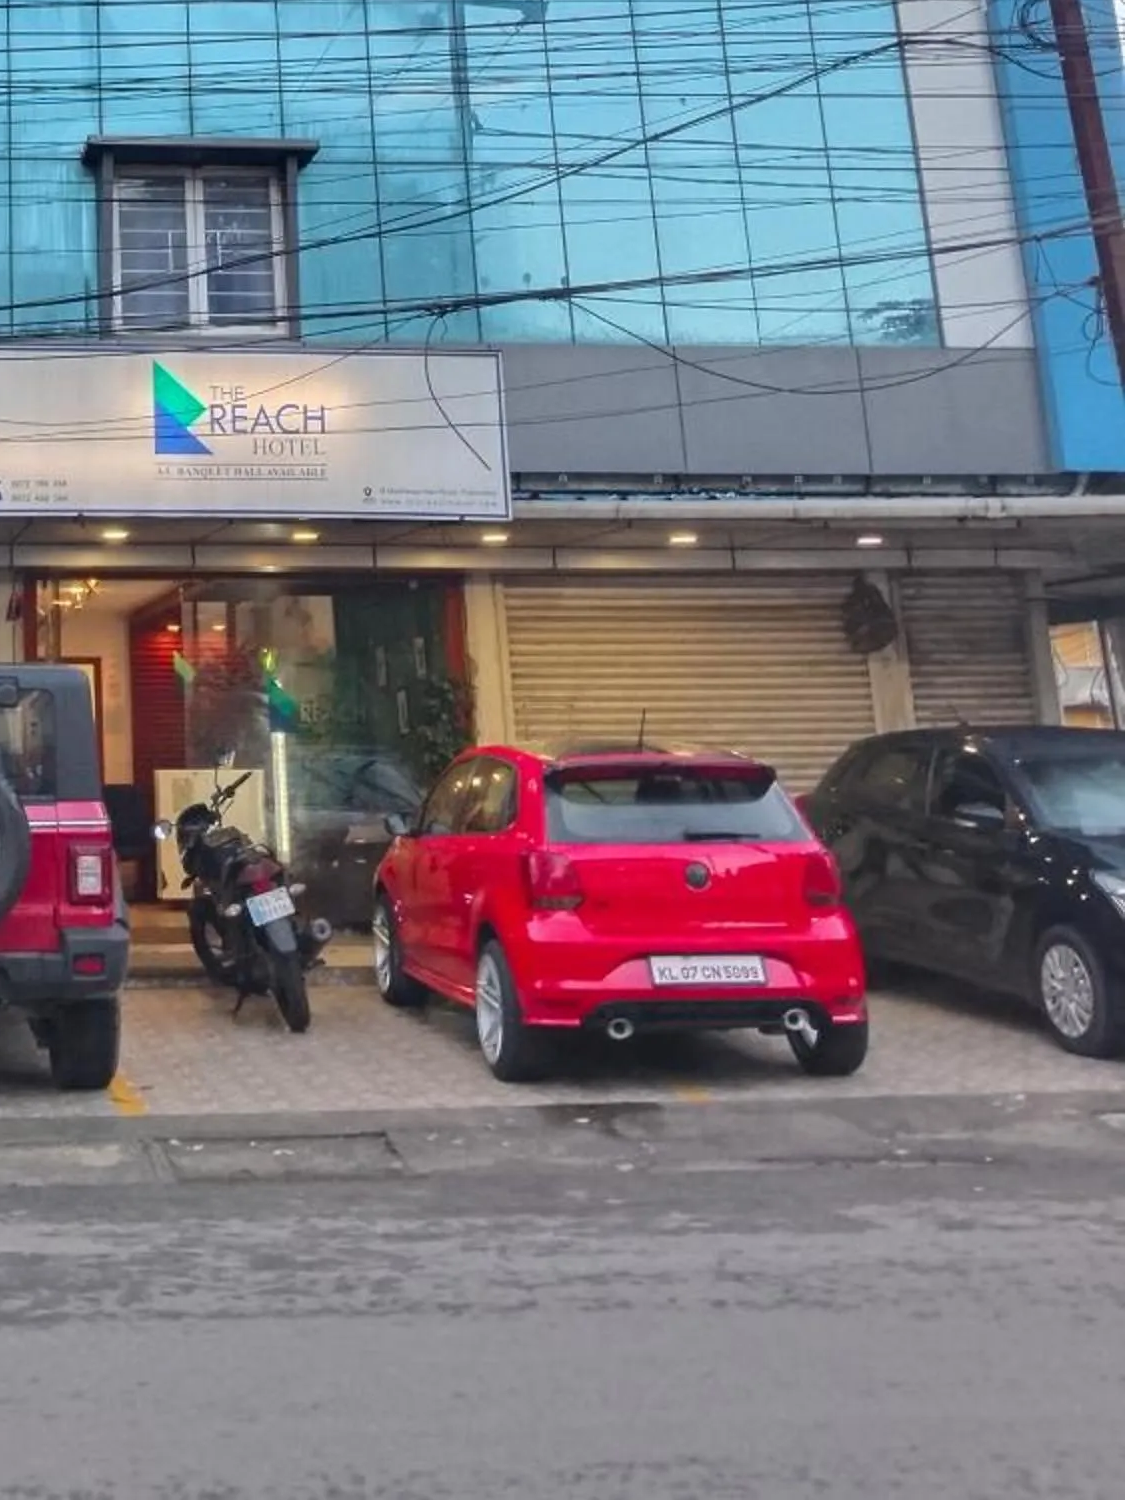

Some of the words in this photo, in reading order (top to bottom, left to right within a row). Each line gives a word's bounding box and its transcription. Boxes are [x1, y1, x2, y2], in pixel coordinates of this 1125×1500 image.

[210, 385, 245, 401] THE
[210, 403, 325, 434] REACH
[253, 437, 326, 456] HOTEL
